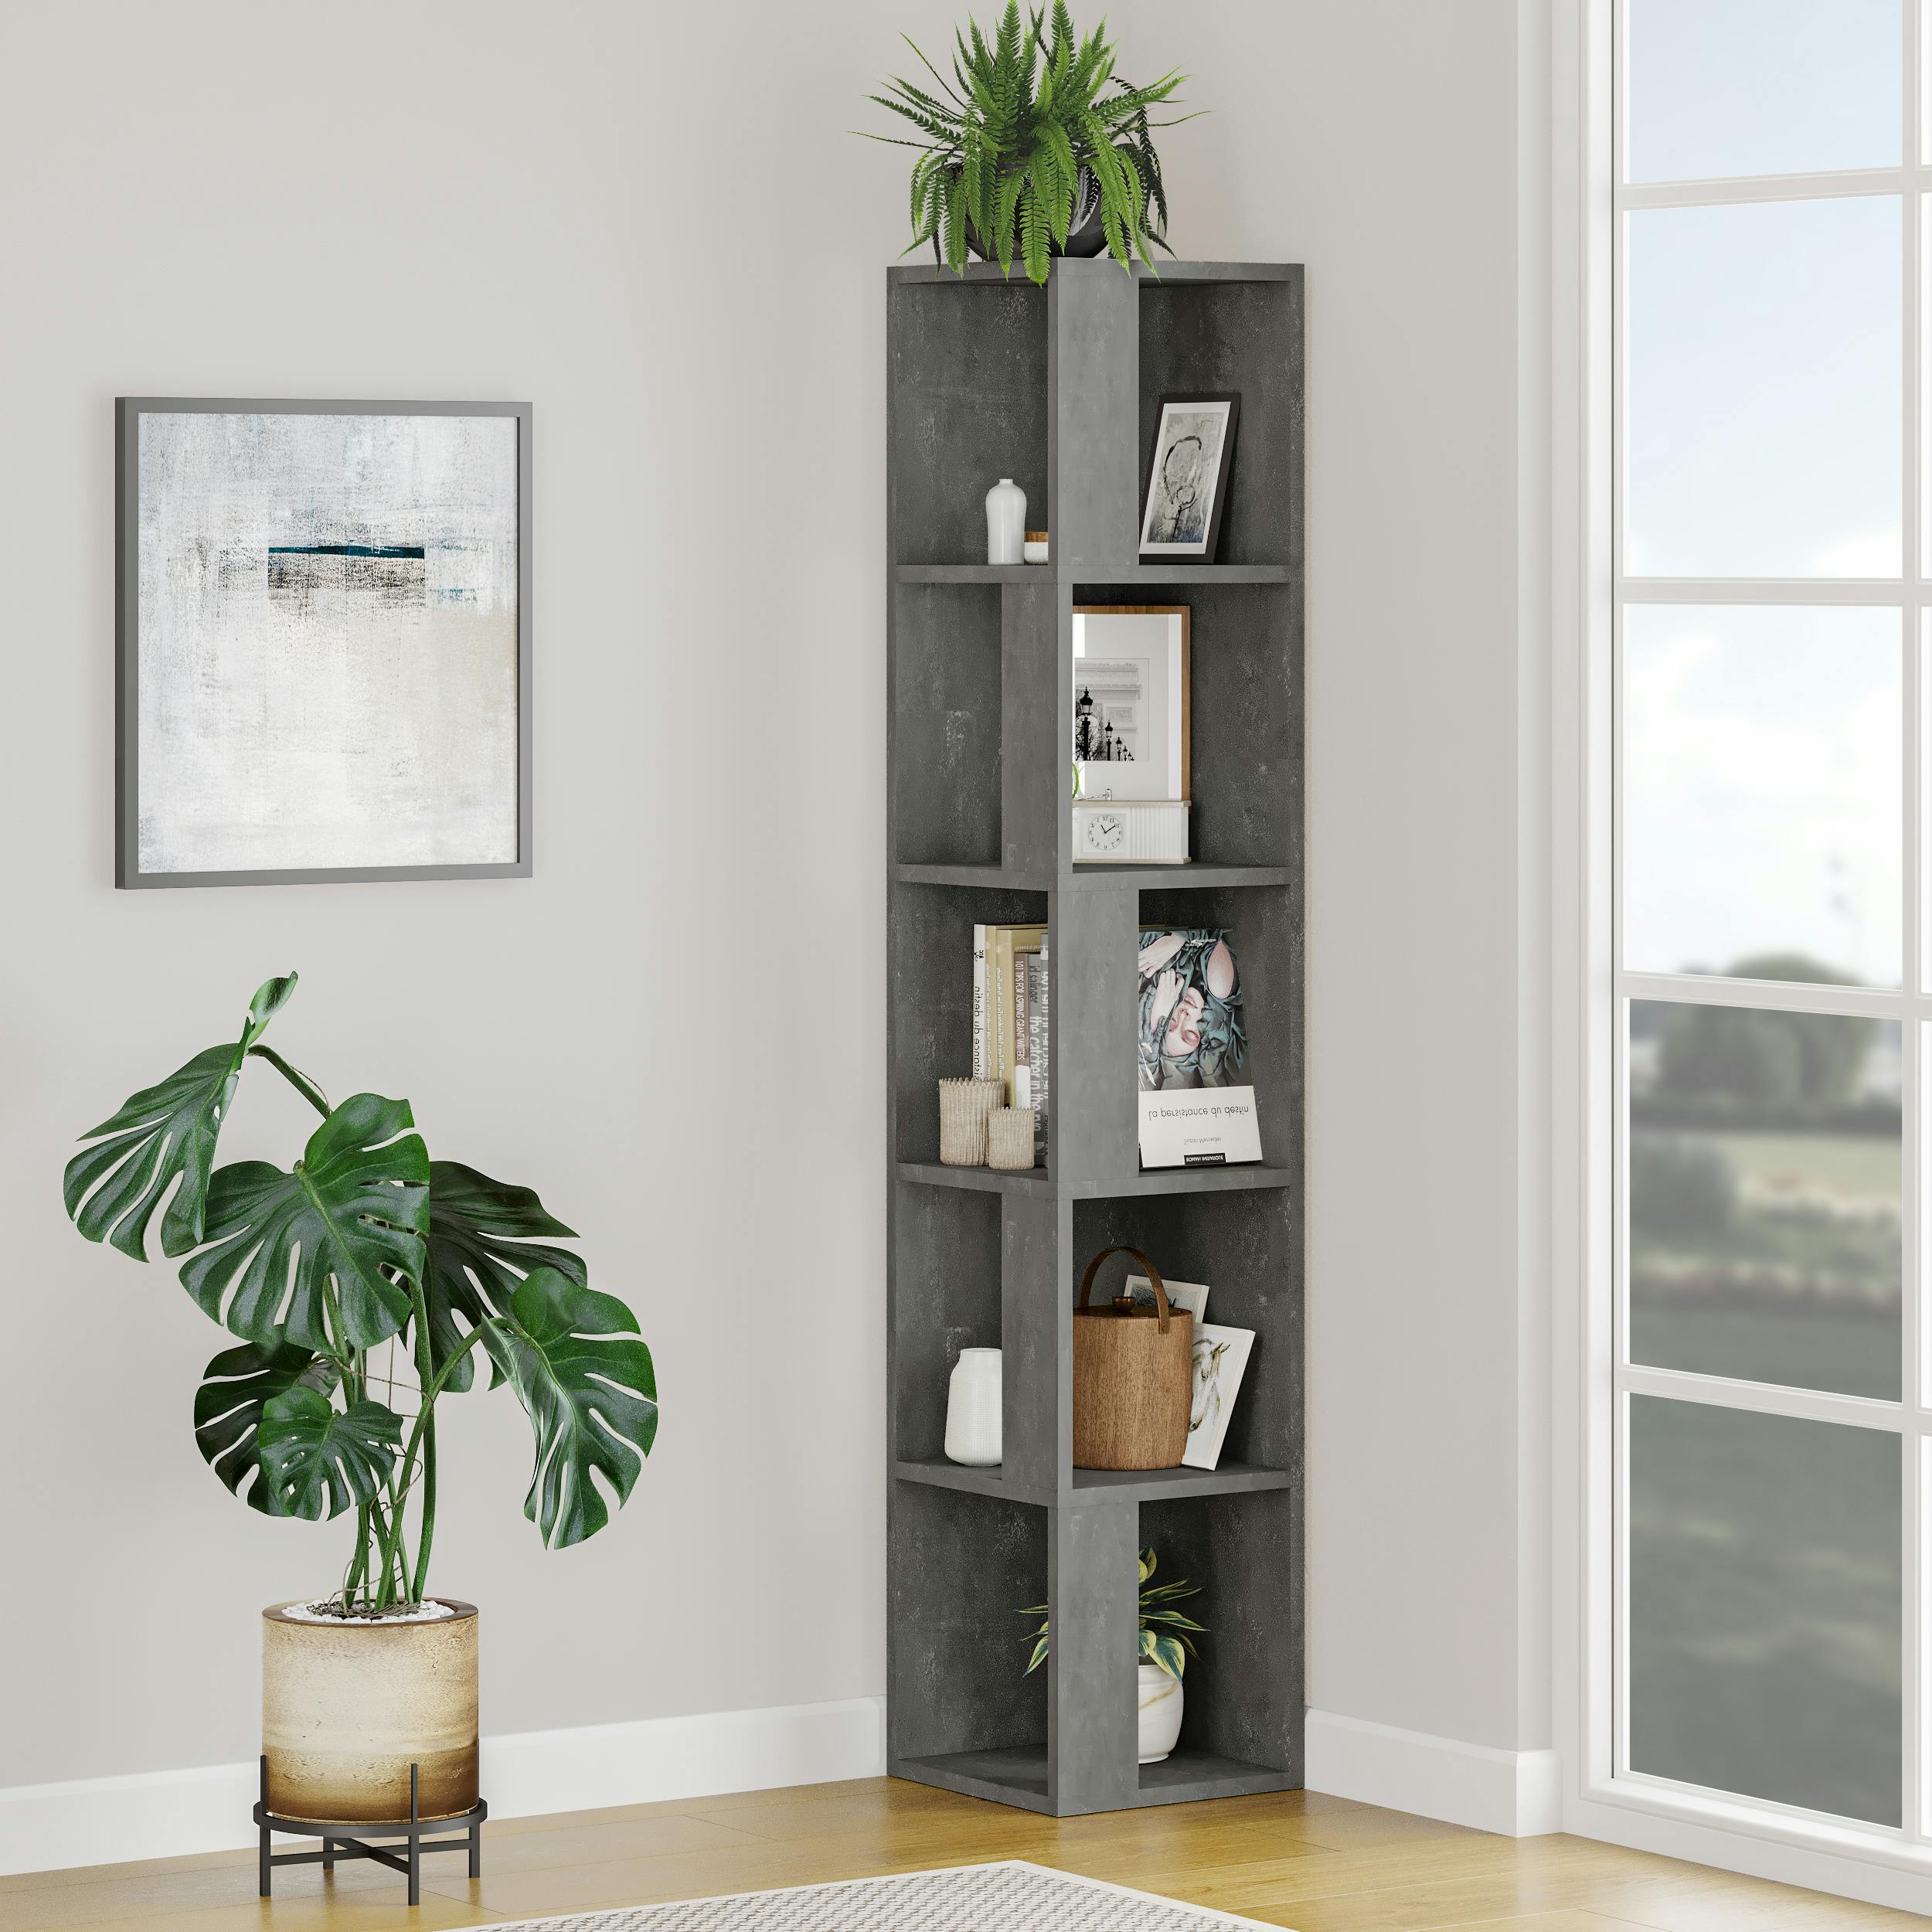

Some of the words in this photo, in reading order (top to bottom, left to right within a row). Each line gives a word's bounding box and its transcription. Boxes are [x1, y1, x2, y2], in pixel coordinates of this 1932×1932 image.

[1015, 961, 1024, 971] 101
[1015, 971, 1024, 982] TIPS
[1015, 982, 1024, 993] FOR
[1029, 975, 1041, 1004] salinger
[1015, 994, 1025, 1019] ASPIRING
[1016, 1019, 1025, 1037] GRANT
[1029, 1015, 1043, 1033] the
[1016, 1038, 1026, 1060] WRITERS
[1030, 1036, 1043, 1077] catcher
[1030, 1080, 1041, 1090] in
[1031, 1094, 1044, 1111] the
